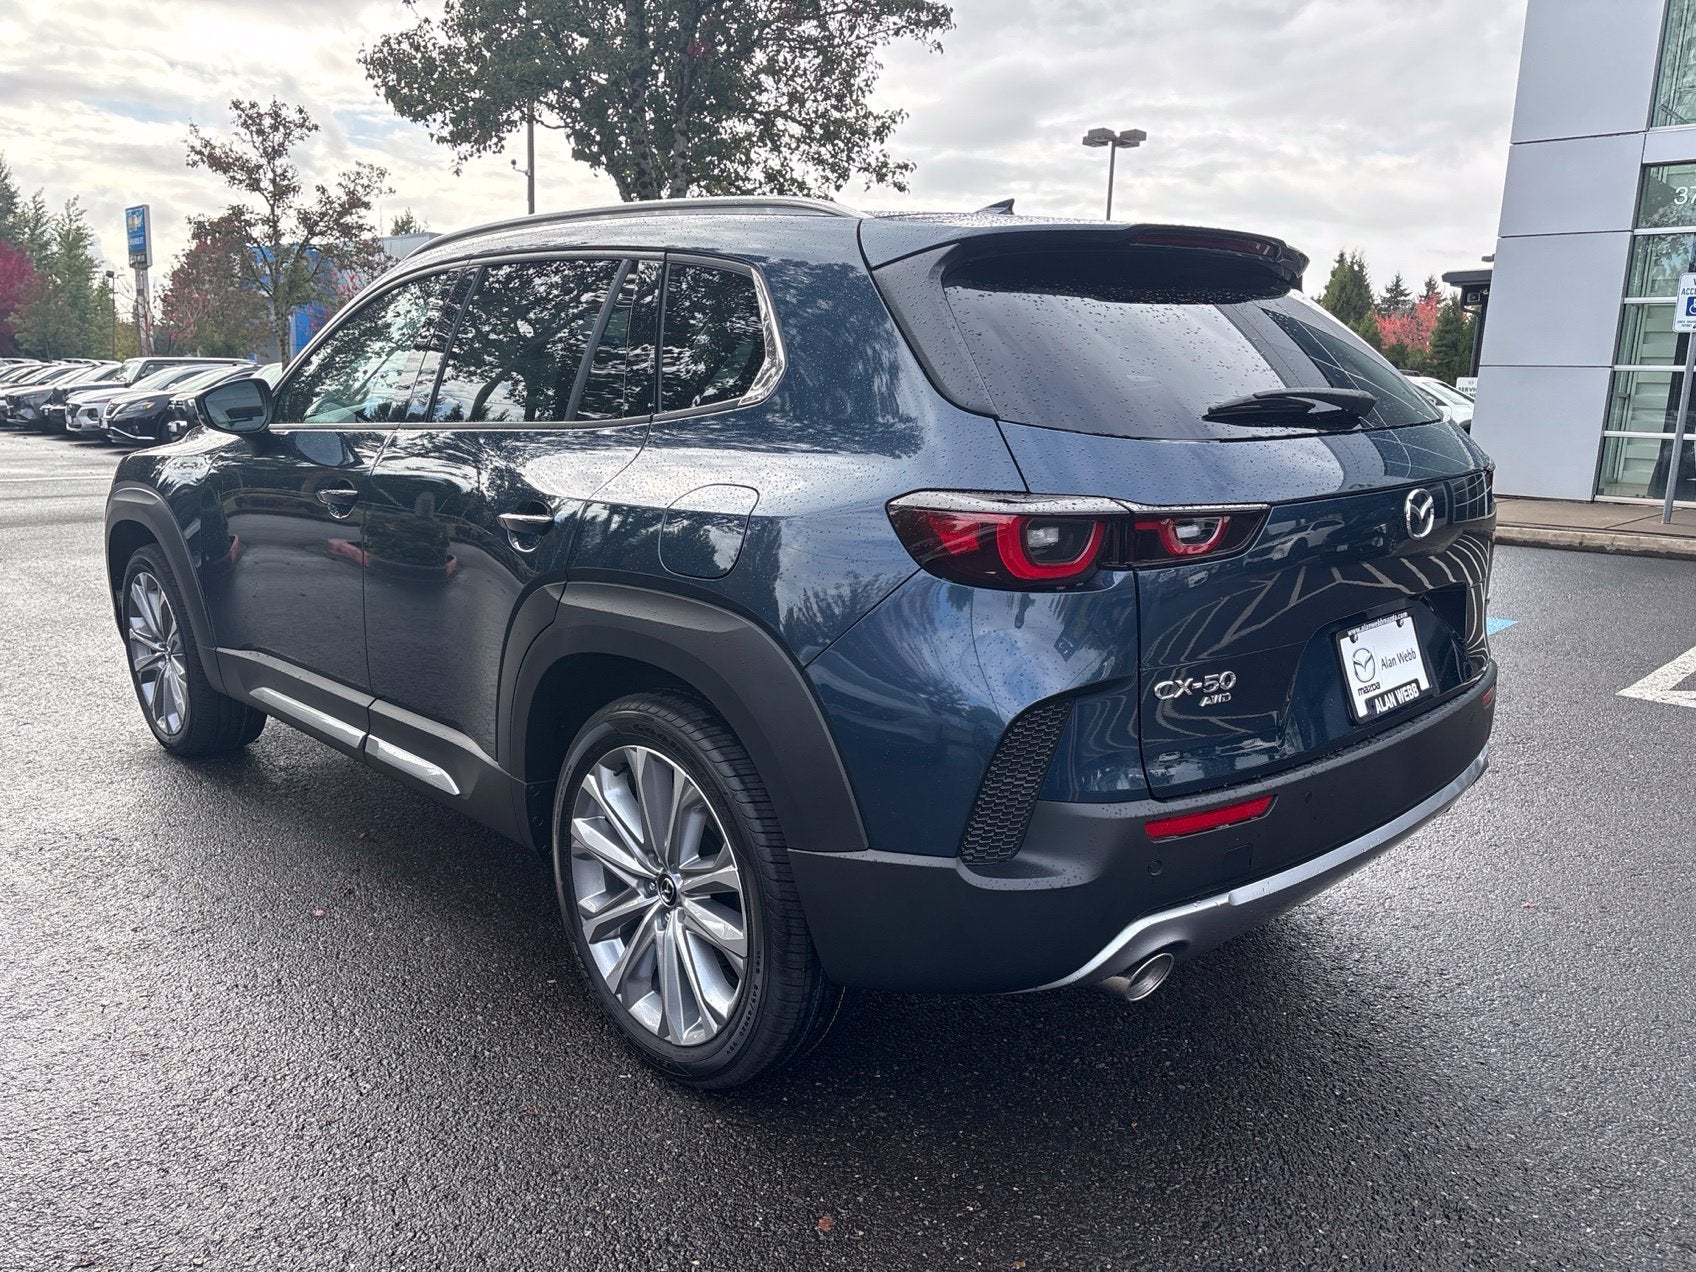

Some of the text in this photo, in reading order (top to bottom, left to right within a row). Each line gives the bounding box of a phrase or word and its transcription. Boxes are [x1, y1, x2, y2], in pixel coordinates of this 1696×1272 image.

[1381, 648, 1417, 671] Alan Webb
[1154, 671, 1237, 700] CX-50
[1375, 682, 1420, 714] ALAN WEBB
[1199, 692, 1232, 707] AWD
